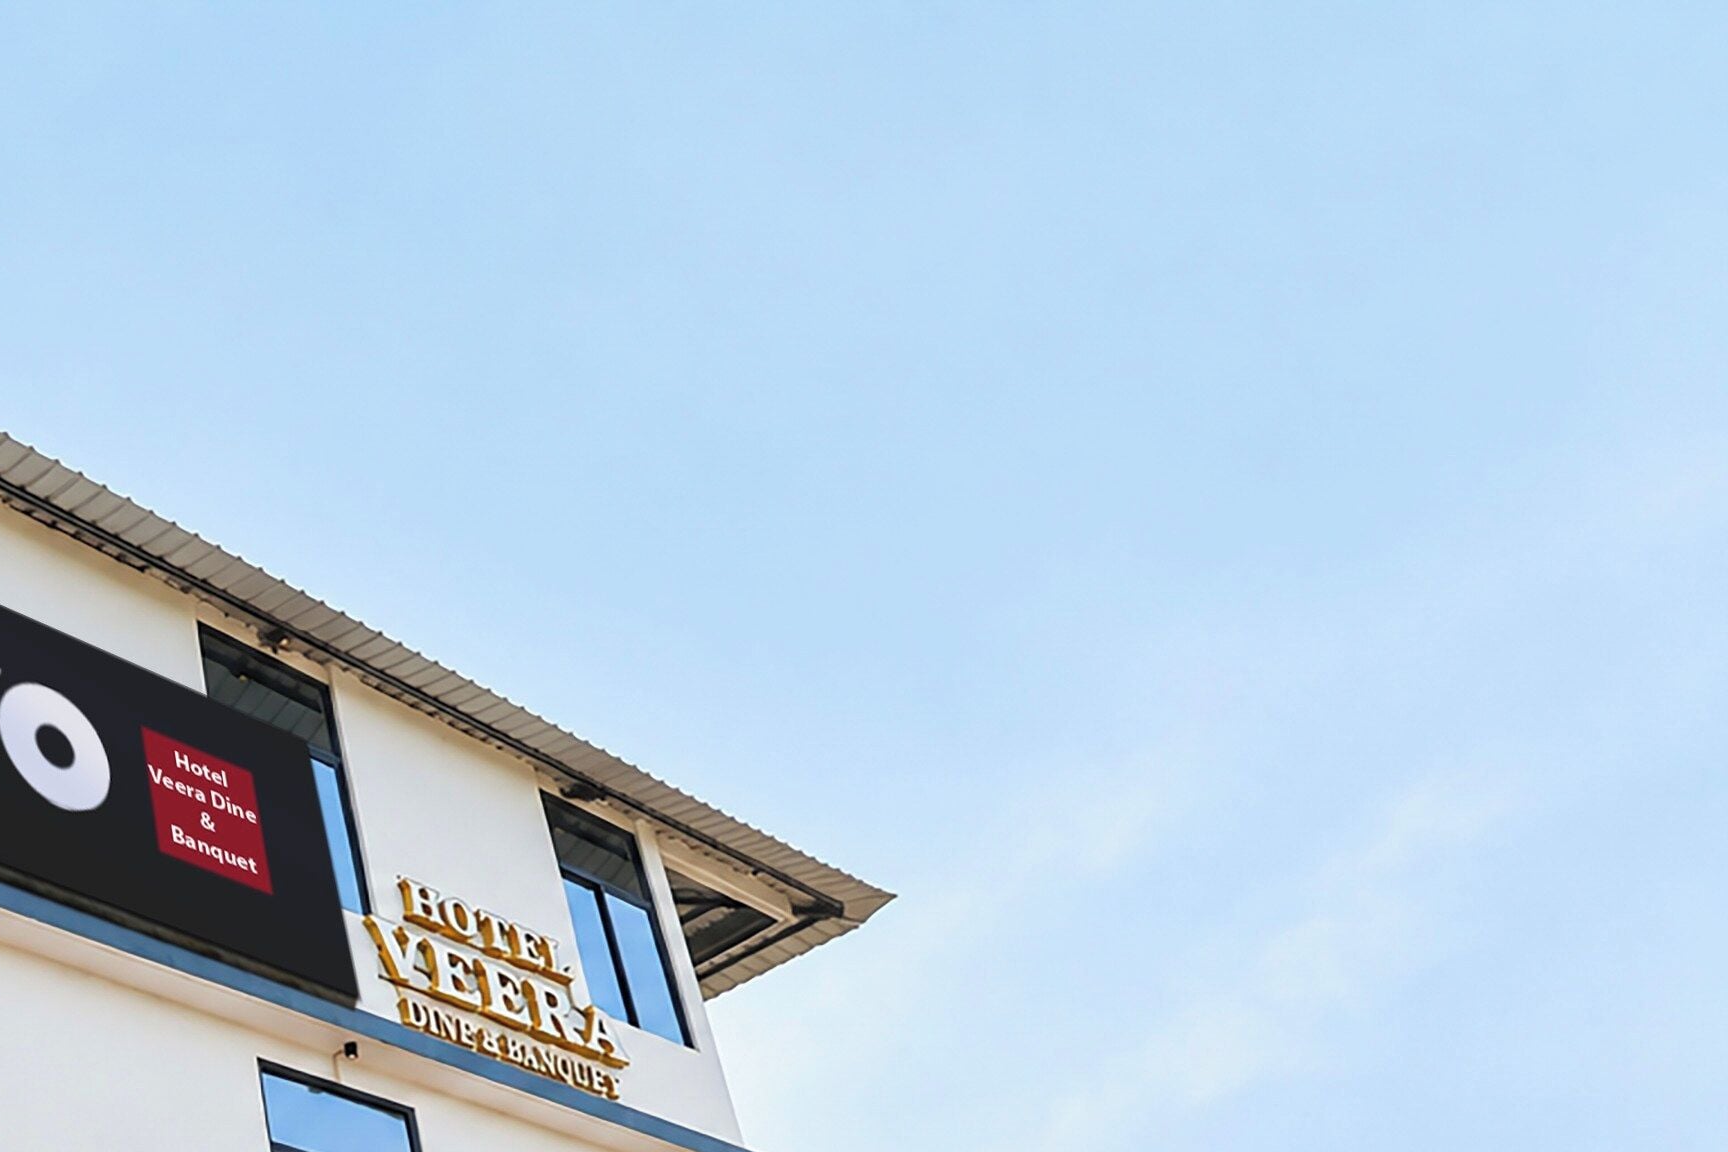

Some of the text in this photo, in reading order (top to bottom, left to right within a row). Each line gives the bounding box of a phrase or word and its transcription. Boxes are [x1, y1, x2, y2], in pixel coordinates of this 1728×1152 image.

[147, 764, 257, 824] Veera Dine
[174, 750, 228, 787] Hotel
[171, 823, 258, 874] Banquet
[199, 811, 217, 832] &
[397, 876, 573, 985] HOTEL
[362, 914, 630, 1069] VEERA
